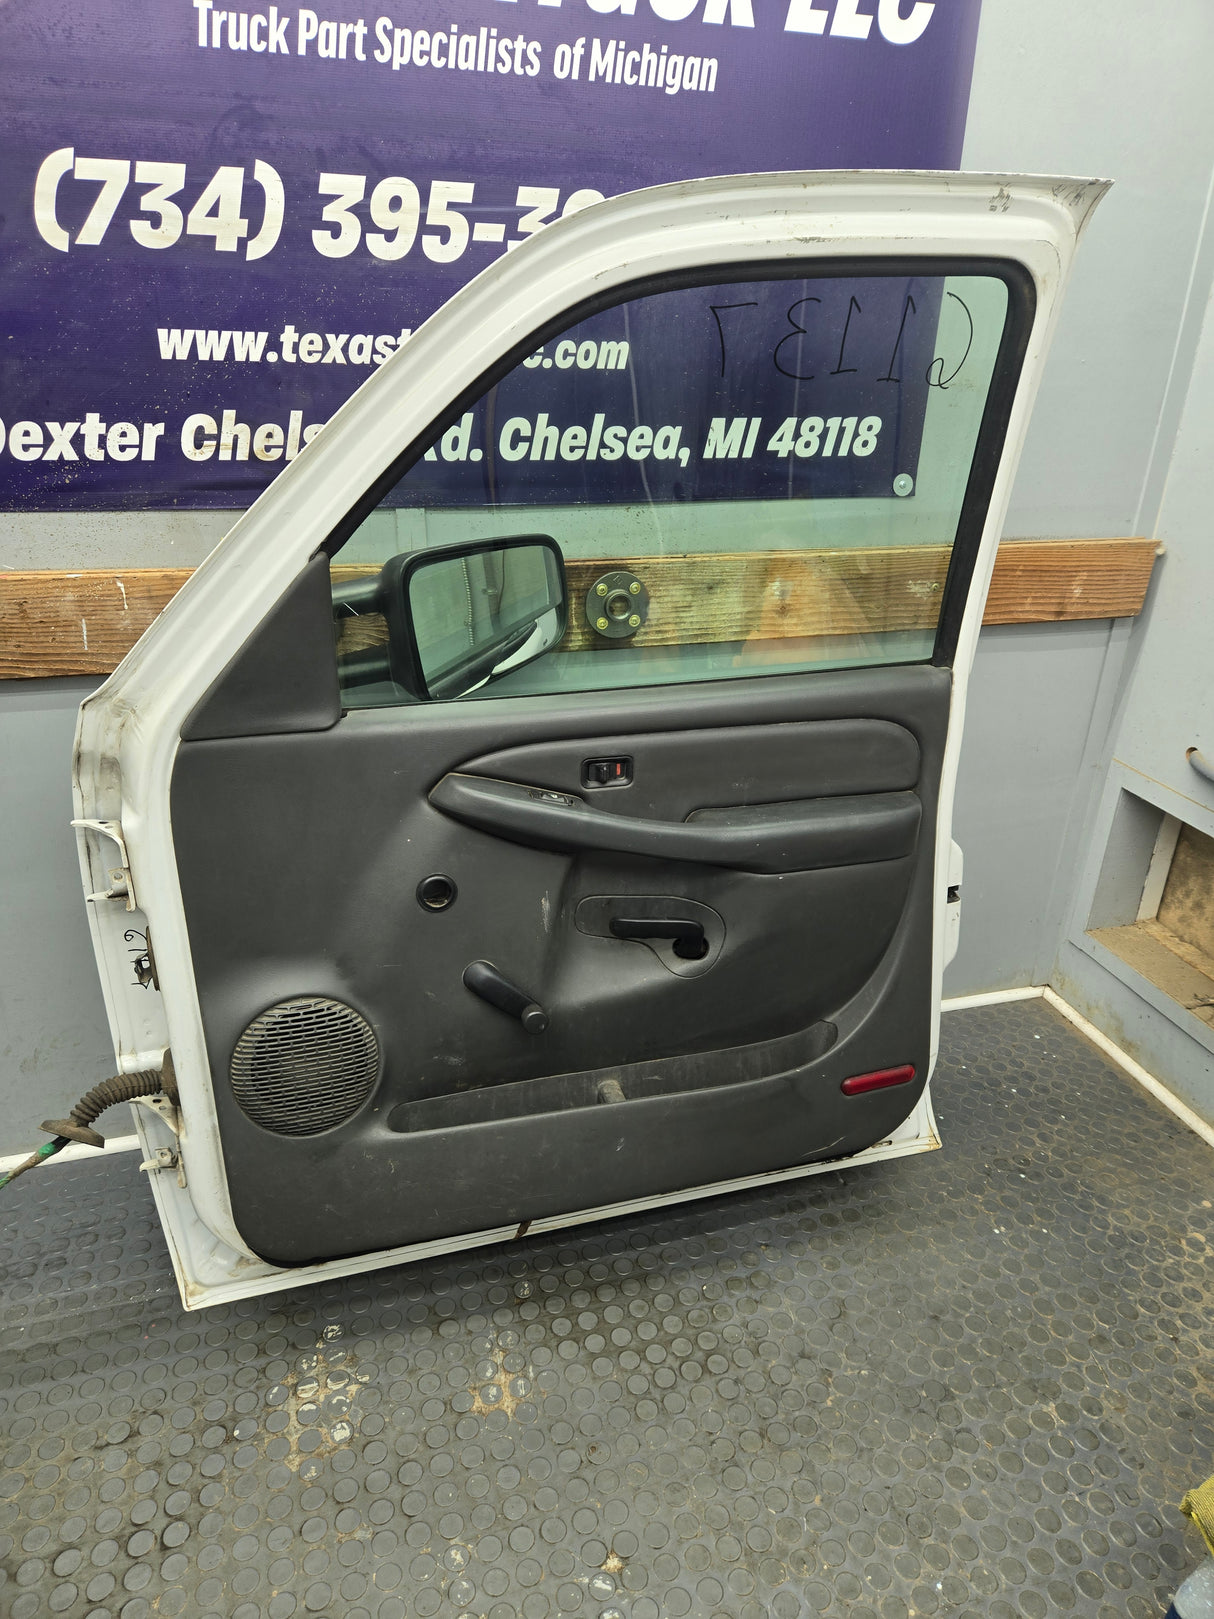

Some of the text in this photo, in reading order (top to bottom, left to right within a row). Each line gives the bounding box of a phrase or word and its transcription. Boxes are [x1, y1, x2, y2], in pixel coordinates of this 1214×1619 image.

[193, 0, 719, 96] Truck Part Specialists of Michigan
[33, 147, 606, 264] (734) 395-3
[0, 409, 883, 468] exter Chel d. Chelsea, MI 48118
